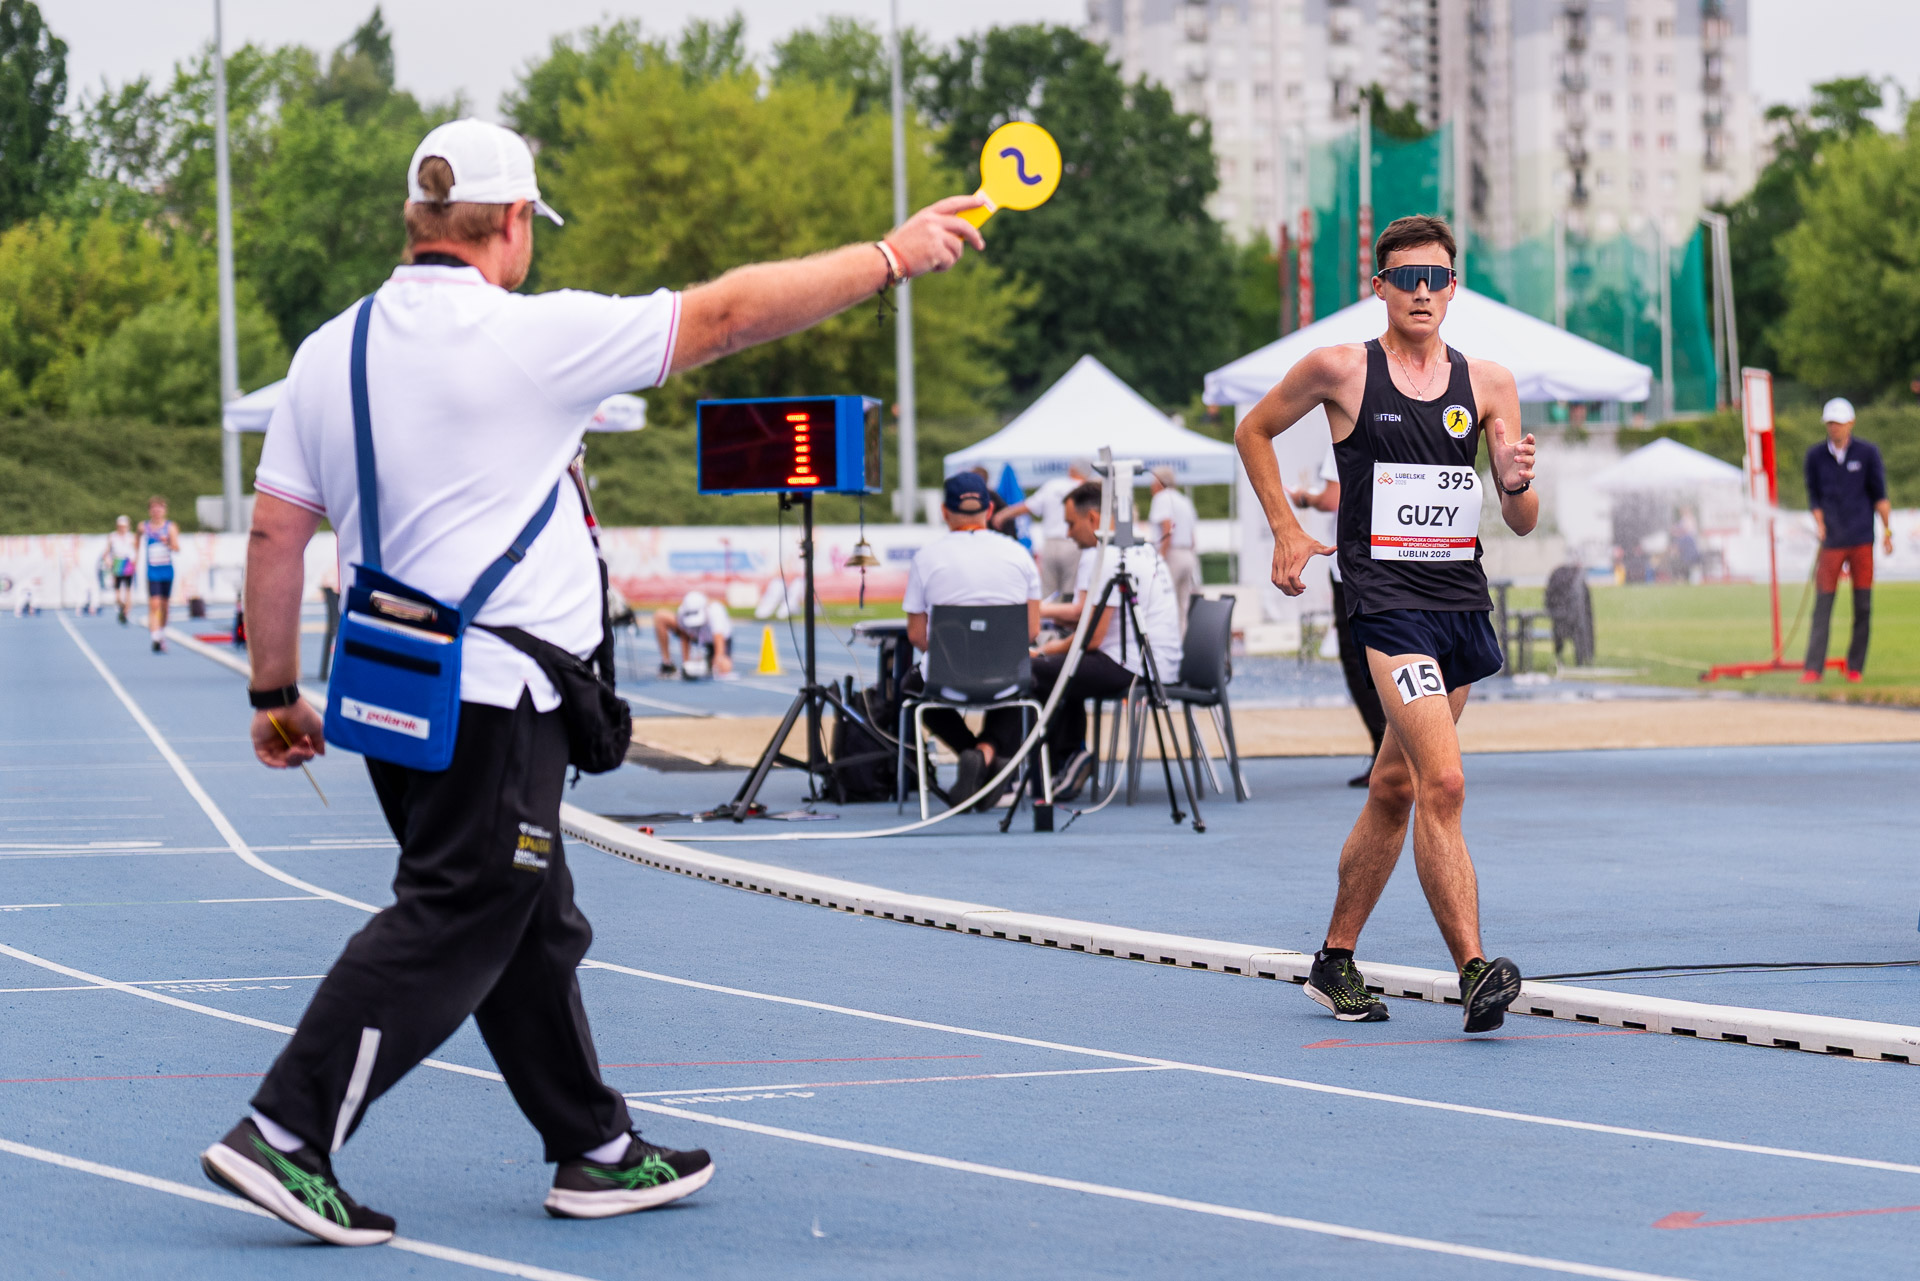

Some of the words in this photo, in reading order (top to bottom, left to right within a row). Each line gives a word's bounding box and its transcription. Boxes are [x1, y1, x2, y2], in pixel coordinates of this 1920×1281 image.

[786, 412, 820, 485] 1
[1395, 472, 1426, 480] LUBELSKIE
[1438, 471, 1474, 490] 395
[1397, 504, 1460, 526] GUZY
[1398, 549, 1429, 558] LUBLIN
[1430, 550, 1452, 558] 2026
[1396, 664, 1442, 697] 15
